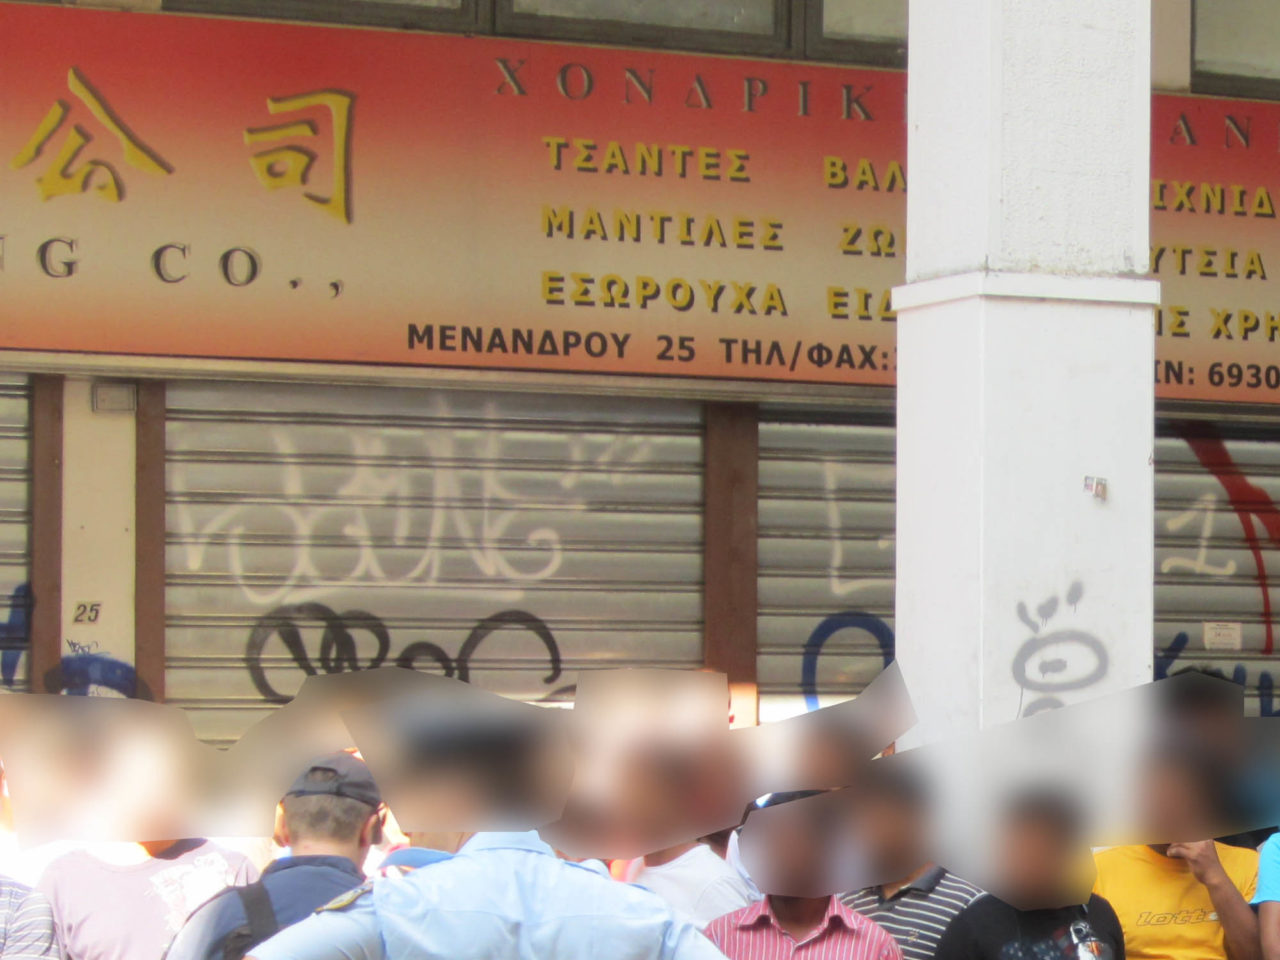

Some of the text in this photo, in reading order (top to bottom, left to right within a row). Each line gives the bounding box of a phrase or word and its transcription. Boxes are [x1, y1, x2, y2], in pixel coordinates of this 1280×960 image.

[494, 57, 908, 123] ΧΟΝΔΡΙΚ
[9, 65, 354, 225] 公司
[542, 136, 751, 183] ΤΣΑΝΤΕΣ
[823, 155, 907, 193] ΒΑΛ
[0, 236, 78, 279] G
[541, 205, 1268, 281] ΜΑΝΤΙΛΕΣ ΖΩ ΥΤΣΙΑ
[540, 269, 789, 317] ΕΣΩΡΟΥΧΑ
[827, 285, 897, 322] ΕΙΔ
[407, 323, 632, 359] ΜΕΝΑΝΔΡΟΥ
[656, 334, 697, 363] 25
[719, 338, 898, 372] ΤΗΛ/ΦΑΧ:
[74, 603, 101, 623] 25
